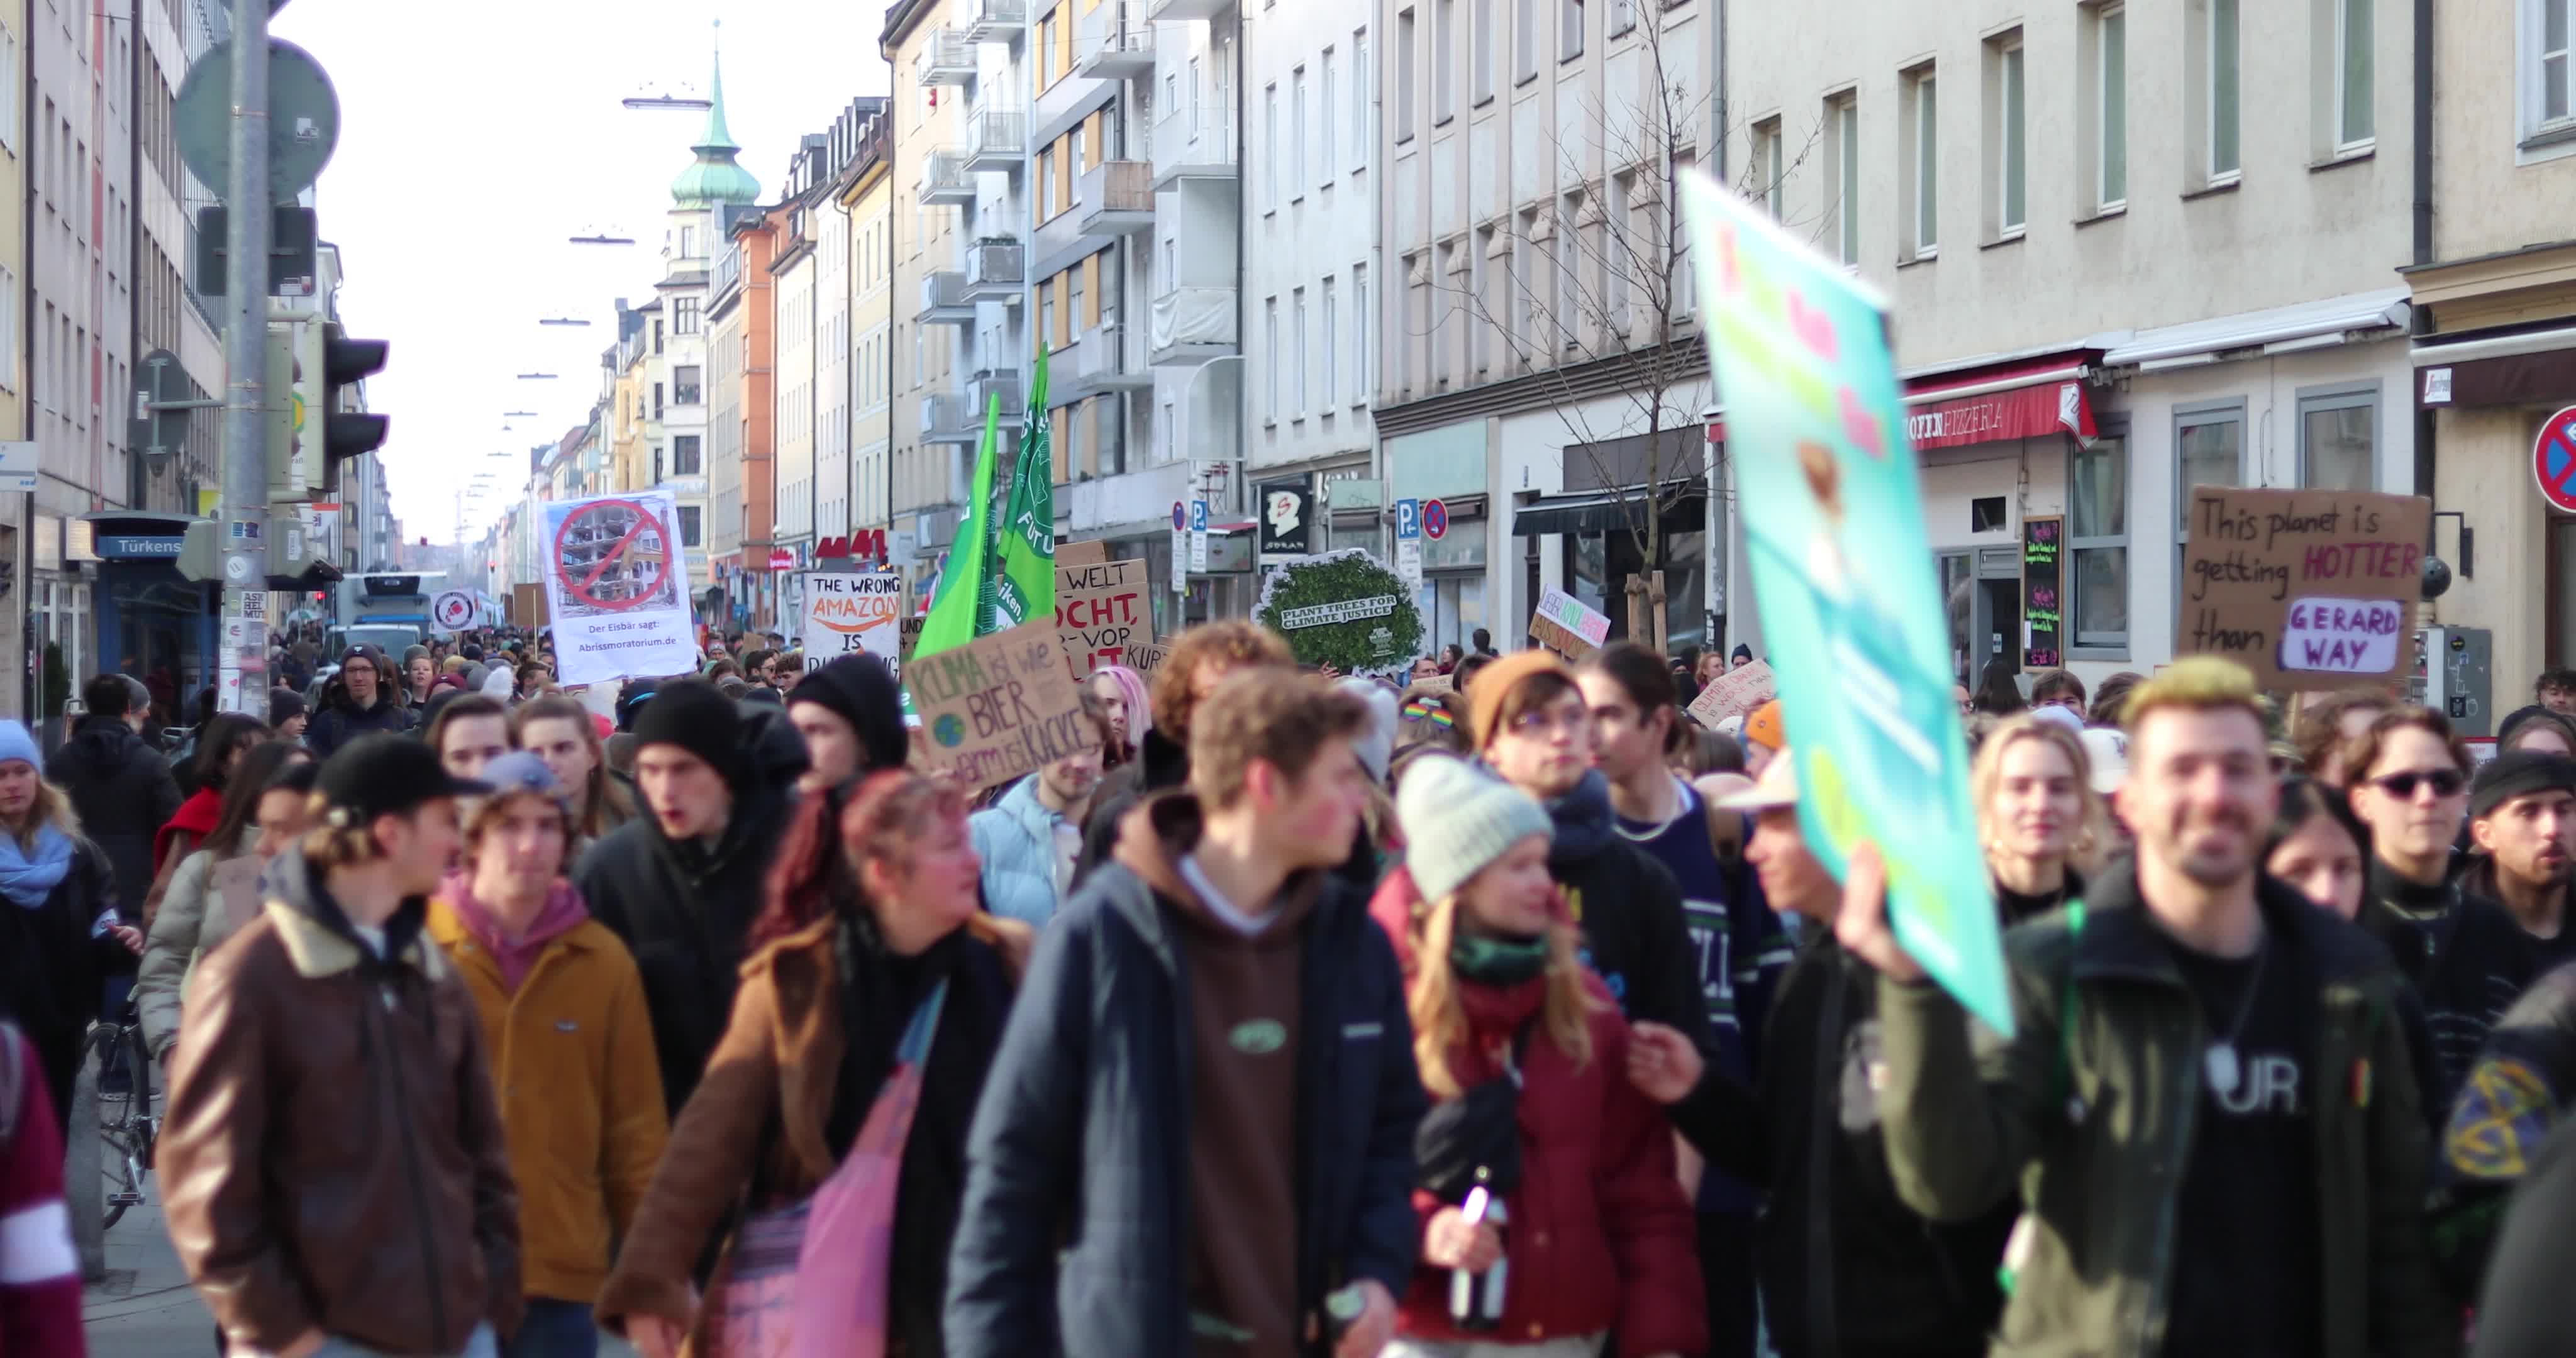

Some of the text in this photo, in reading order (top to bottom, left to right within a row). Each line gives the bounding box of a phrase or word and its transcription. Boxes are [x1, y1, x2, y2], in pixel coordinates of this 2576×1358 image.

[1942, 402, 2003, 437] PIZZERIA
[1194, 504, 1203, 529] P
[1399, 504, 1413, 534] P
[2197, 497, 2381, 551] This planet is
[1066, 563, 1130, 590] WELT
[2192, 541, 2420, 601] getting HOTTER
[813, 577, 901, 594] THE WRONG
[813, 596, 900, 618] AMAZON
[1282, 596, 1396, 621] PLANT TREES FOR
[1283, 605, 1391, 629] CLIMATE JUSTICE
[589, 621, 660, 633] Der Eisbär sagt:
[2193, 604, 2399, 652] than GERARD
[578, 636, 677, 652] Abrissmoratorium.de
[841, 634, 862, 652] IS
[2302, 638, 2370, 669] WAY
[910, 649, 988, 709] KLIMA
[966, 680, 1039, 739] BIER
